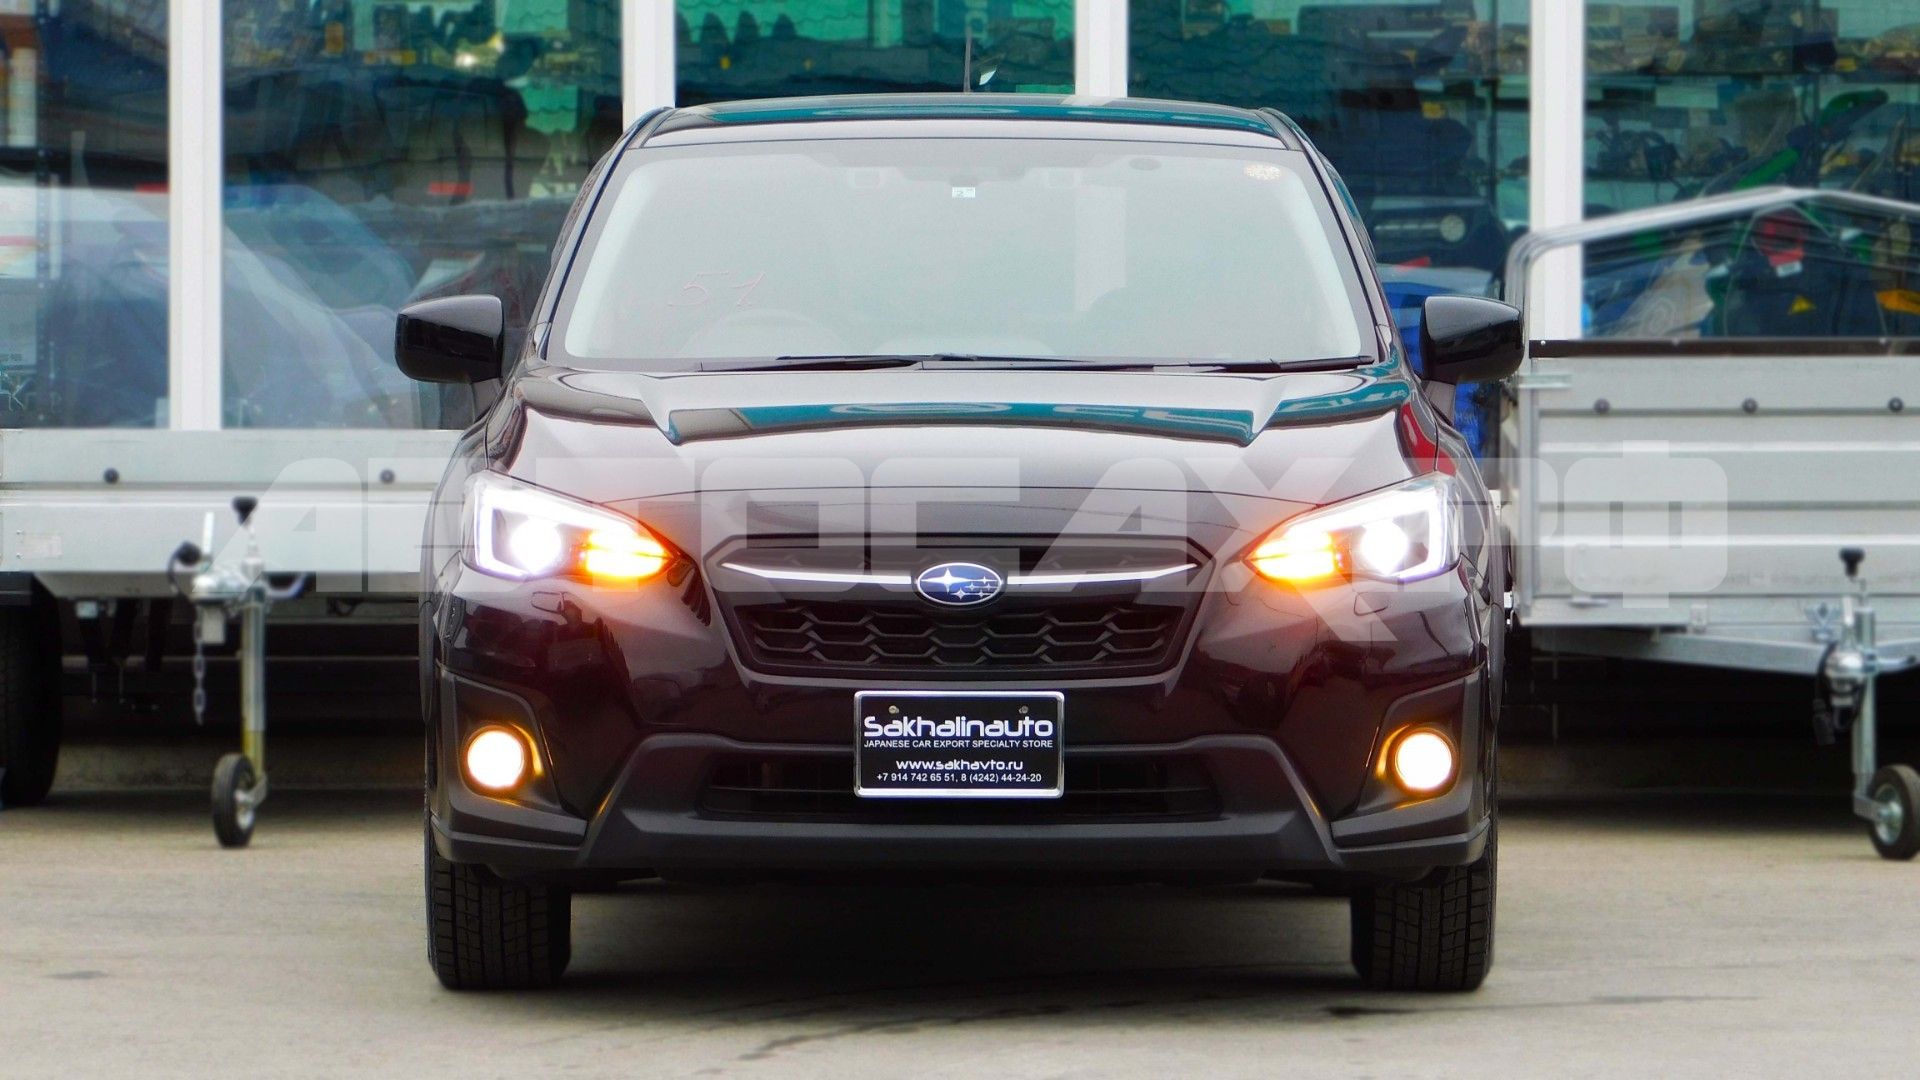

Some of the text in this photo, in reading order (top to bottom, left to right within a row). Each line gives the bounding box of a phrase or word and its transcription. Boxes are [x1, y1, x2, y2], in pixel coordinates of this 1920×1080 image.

[864, 716, 1053, 737] Sakhalinauto
[864, 740, 1053, 748] JAPANESE CAR EXPORT SPECIALTY STORE
[896, 759, 1023, 770] www.sakhavto.ru
[877, 773, 1042, 783] +7 914 742 65 51, 8 (4242) 44-24-20
